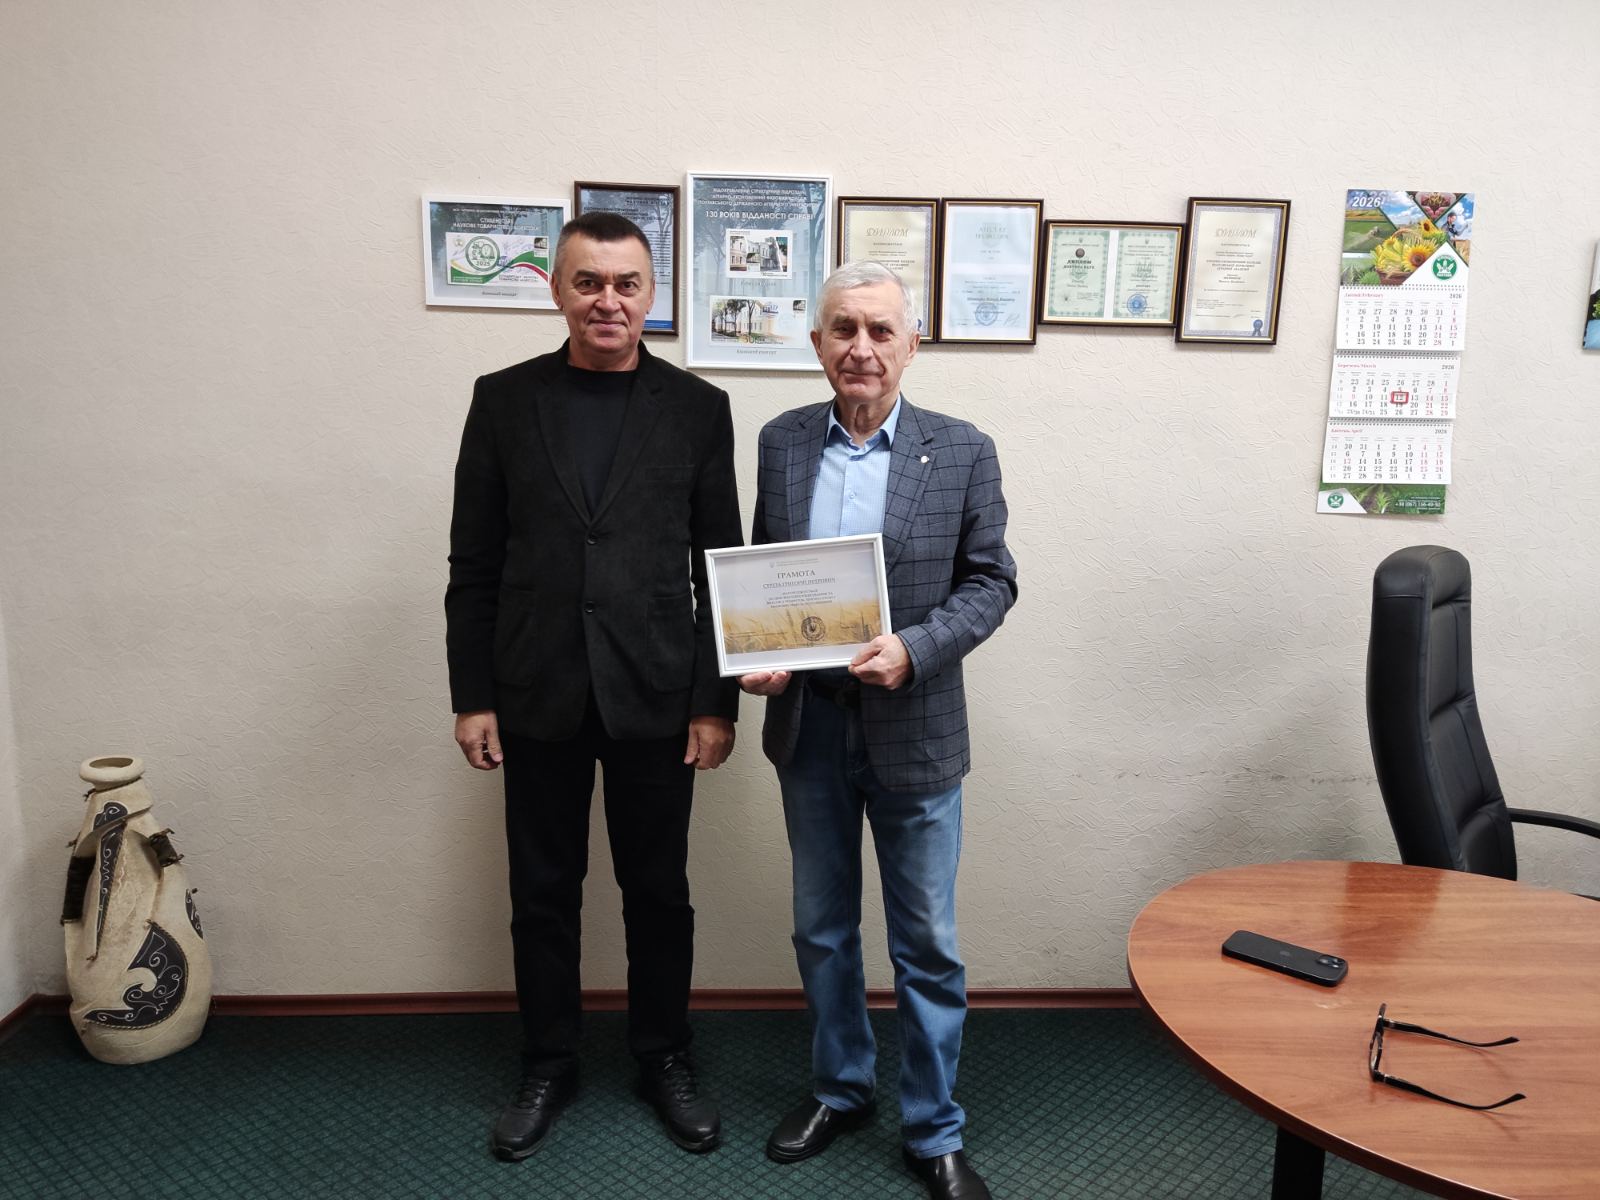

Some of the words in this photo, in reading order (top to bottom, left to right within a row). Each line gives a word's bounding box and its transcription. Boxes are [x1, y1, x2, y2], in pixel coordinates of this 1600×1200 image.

[1352, 196, 1380, 207] 2026
[742, 212, 786, 220] ВІДДАНОСТІ
[778, 570, 816, 578] ГРАМОТА
